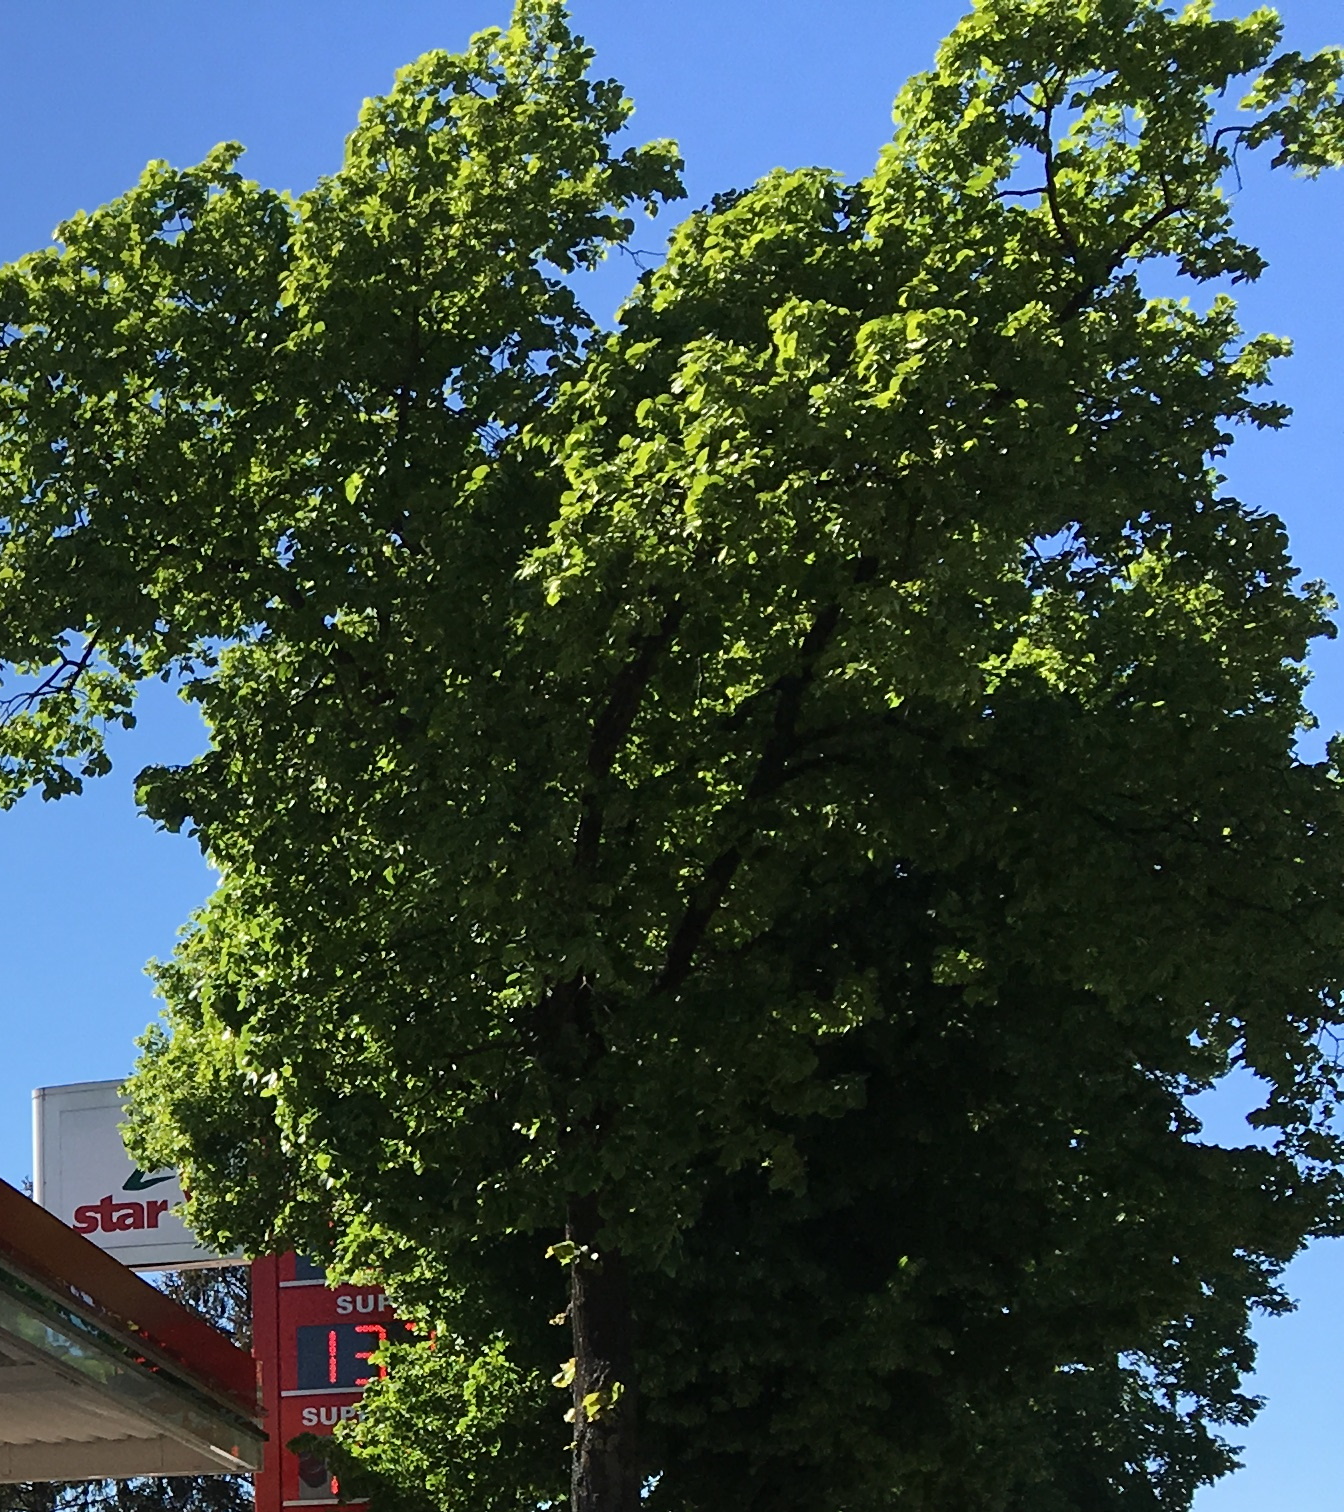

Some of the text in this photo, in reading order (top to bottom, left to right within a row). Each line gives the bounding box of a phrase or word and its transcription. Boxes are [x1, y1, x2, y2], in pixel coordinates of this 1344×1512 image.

[72, 1194, 168, 1235] star
[336, 1294, 393, 1315] SUP
[302, 1405, 365, 1427] SUP
